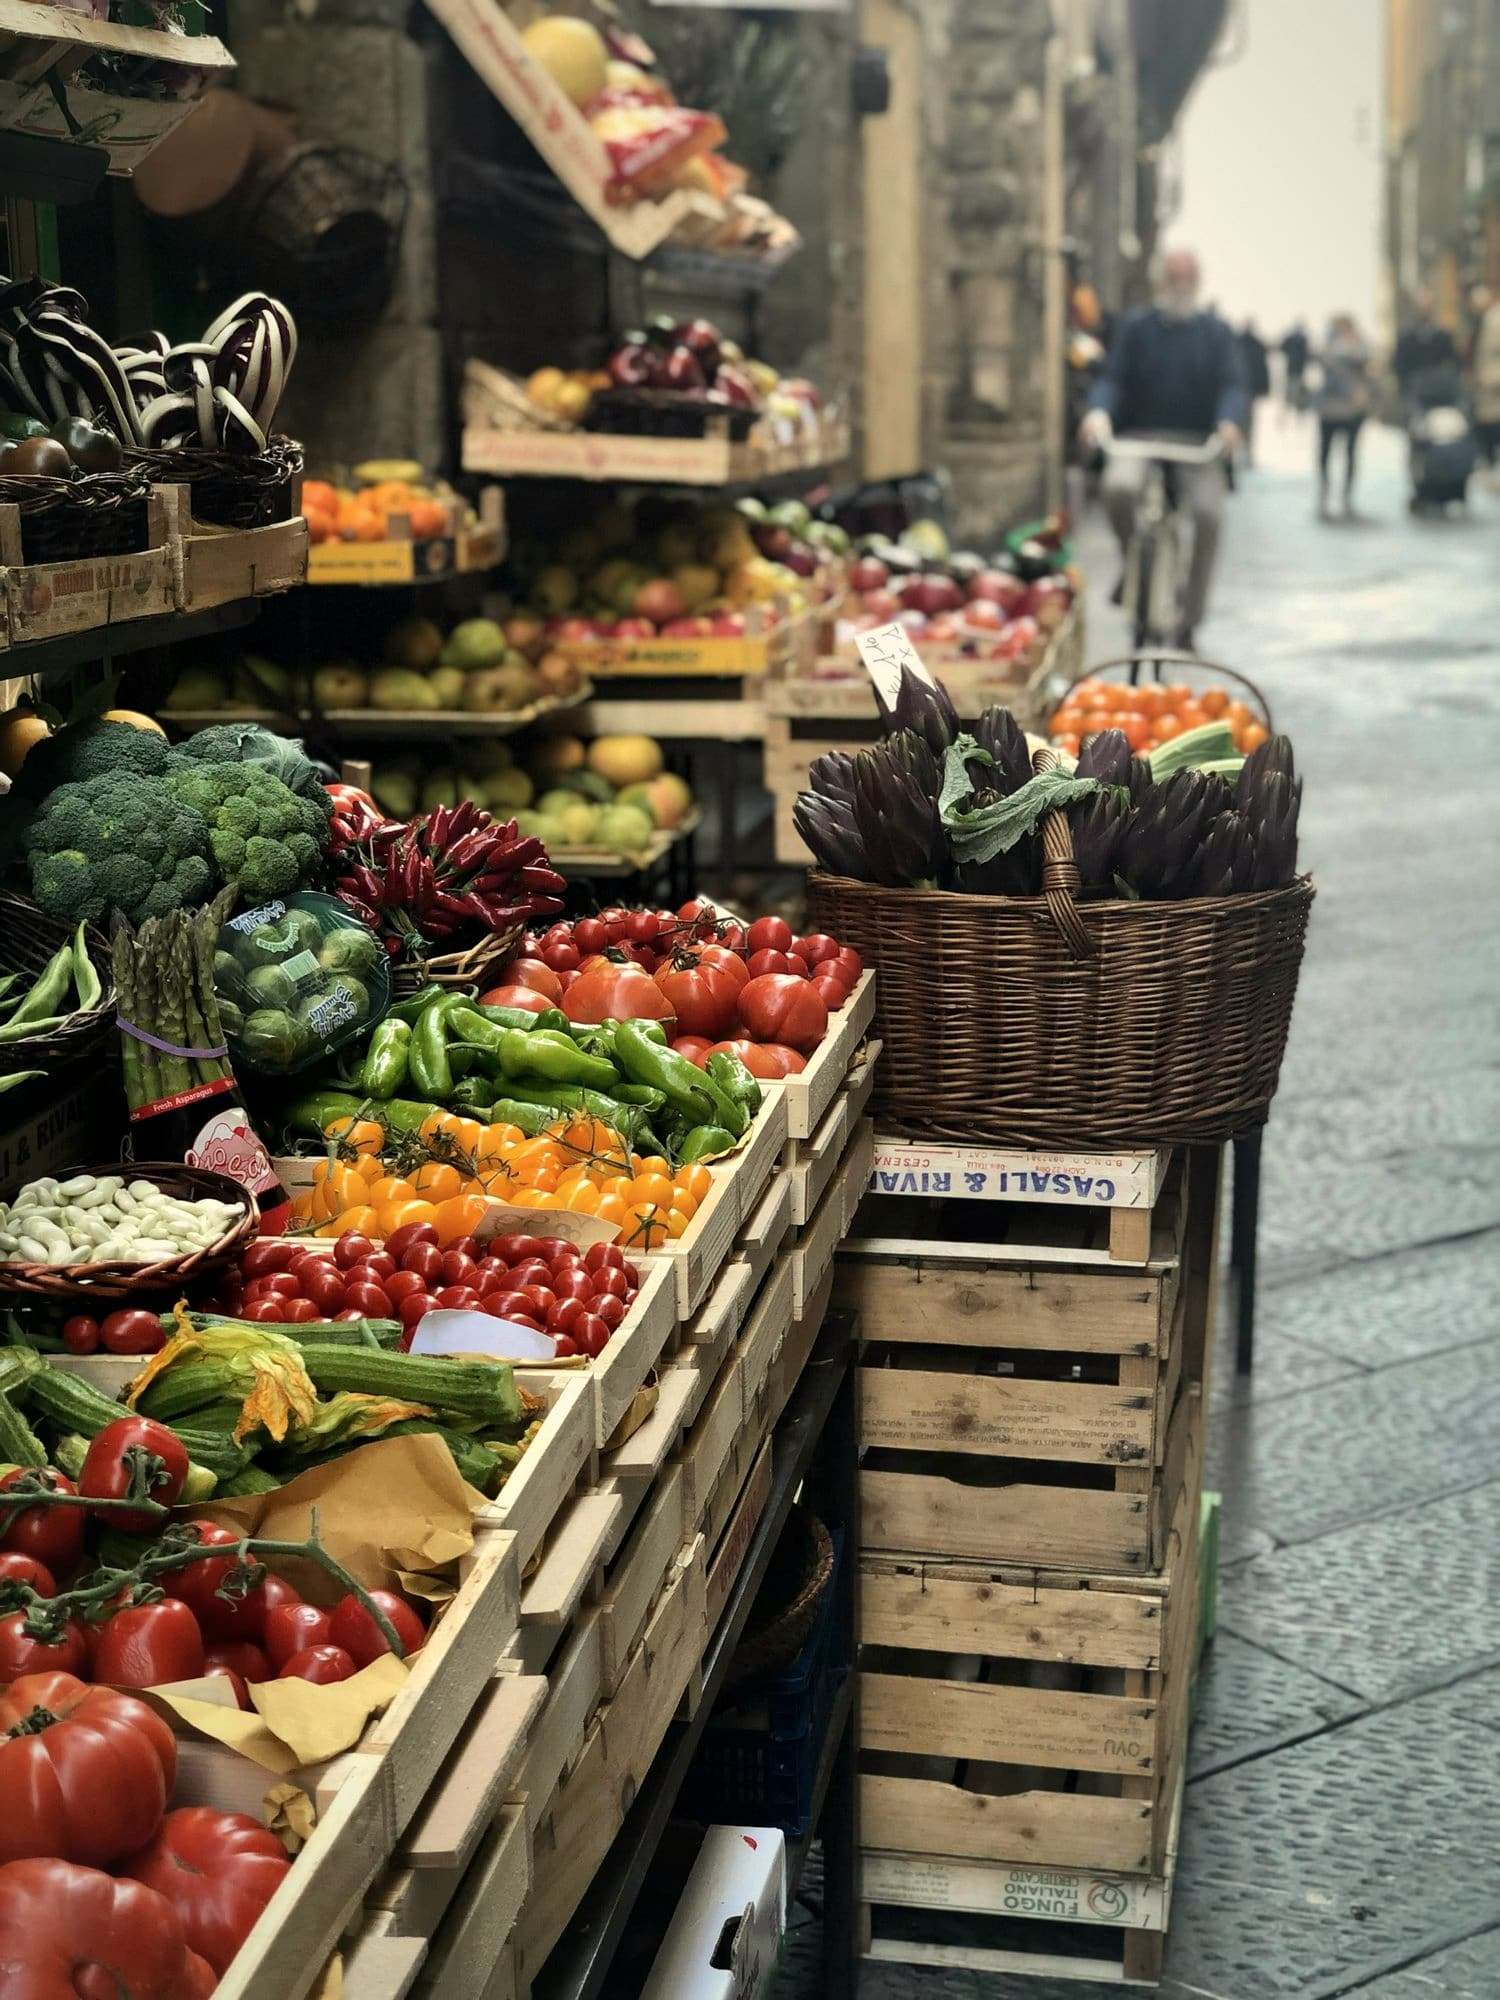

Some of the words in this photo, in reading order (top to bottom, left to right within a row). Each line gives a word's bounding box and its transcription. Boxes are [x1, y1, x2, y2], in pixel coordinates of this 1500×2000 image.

[153, 1100, 173, 1112] Fresh
[175, 1088, 213, 1106] Asparagus
[964, 1172, 987, 1193] &
[1000, 1172, 1115, 1201] CASALI
[1009, 1871, 1079, 1888] CERTIFICATO
[1004, 1883, 1078, 1899] ITALIANO
[1003, 1896, 1078, 1915] FUNGO
